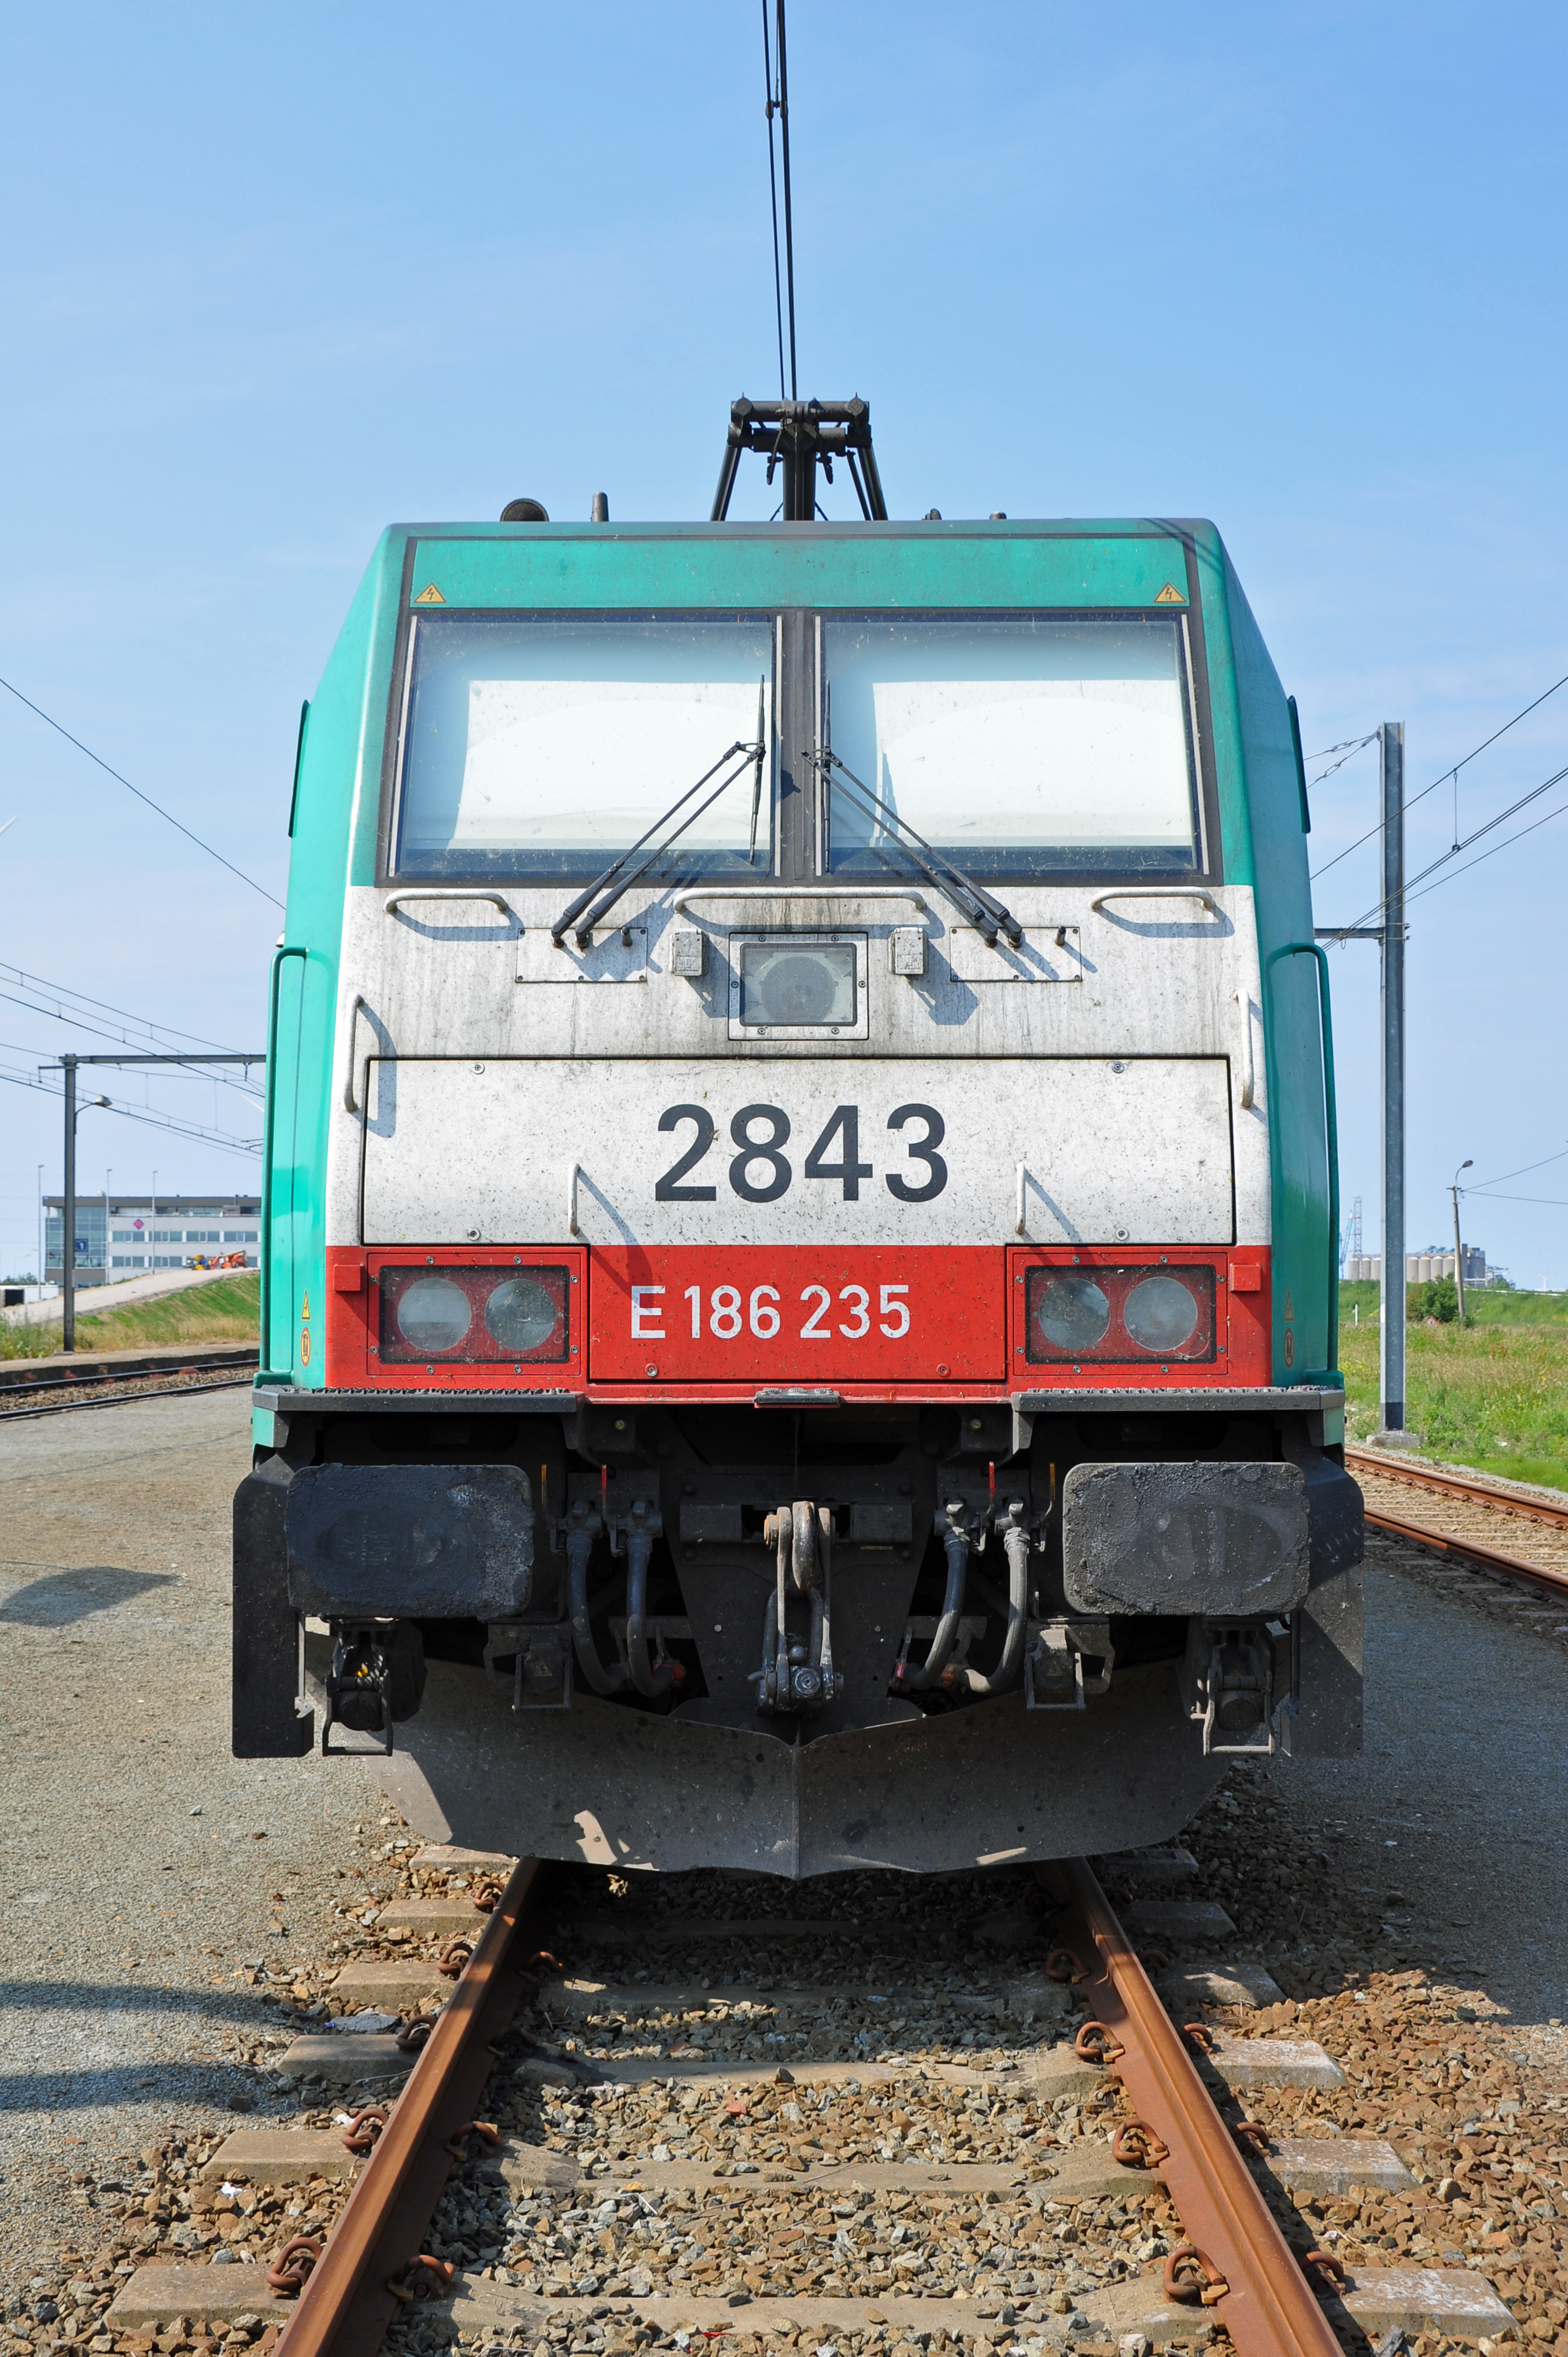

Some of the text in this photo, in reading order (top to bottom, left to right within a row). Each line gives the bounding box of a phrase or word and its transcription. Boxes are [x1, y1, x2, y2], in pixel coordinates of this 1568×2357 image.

[655, 1103, 948, 1203] 2843
[630, 1284, 910, 1339] E 186 235
